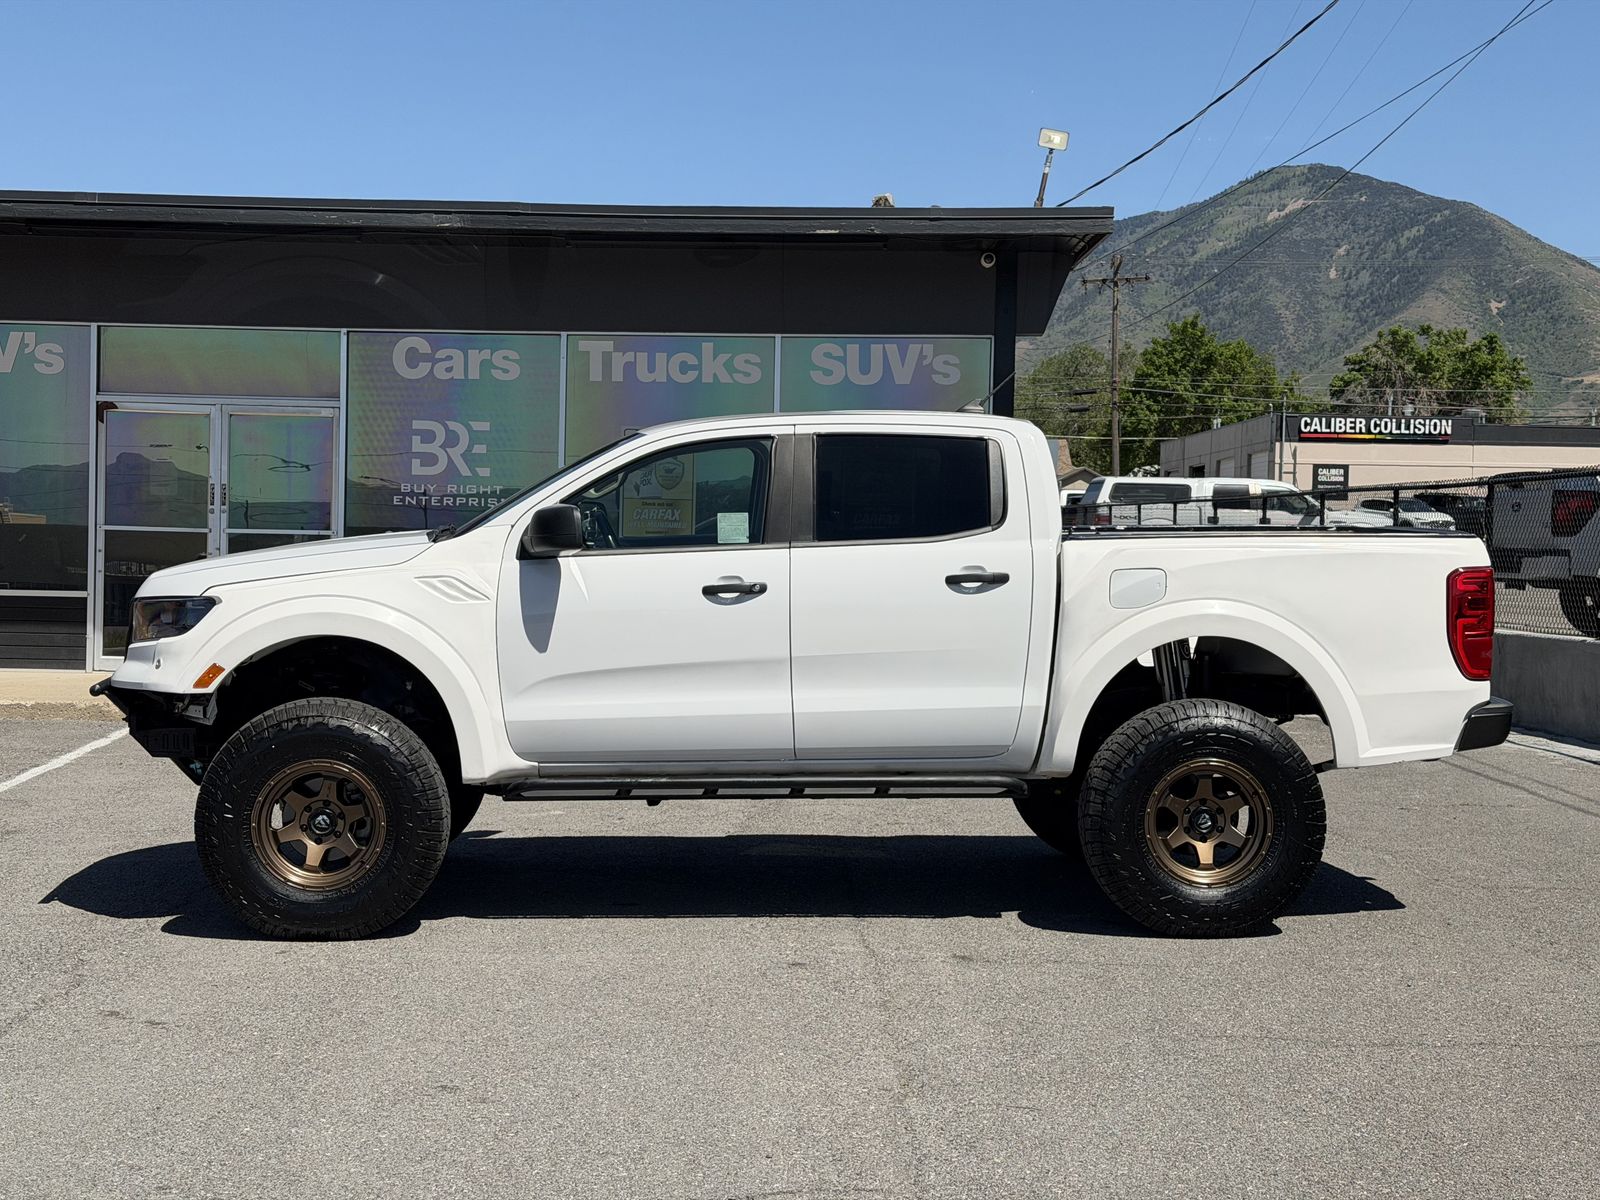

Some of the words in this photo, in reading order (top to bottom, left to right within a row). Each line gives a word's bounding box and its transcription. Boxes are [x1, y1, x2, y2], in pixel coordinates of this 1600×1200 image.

[392, 336, 521, 381] Cars
[578, 340, 762, 385] Trucks
[809, 342, 961, 386] SUV's
[1300, 416, 1366, 433] CALIBER
[1370, 418, 1452, 435] COLLISION
[411, 419, 491, 477] BRE
[1317, 467, 1345, 476] CALIBER
[400, 483, 438, 493] BUY
[447, 484, 504, 495] RIGHT
[393, 495, 505, 508] ENTERPRIS
[632, 508, 681, 521] CARFAX
